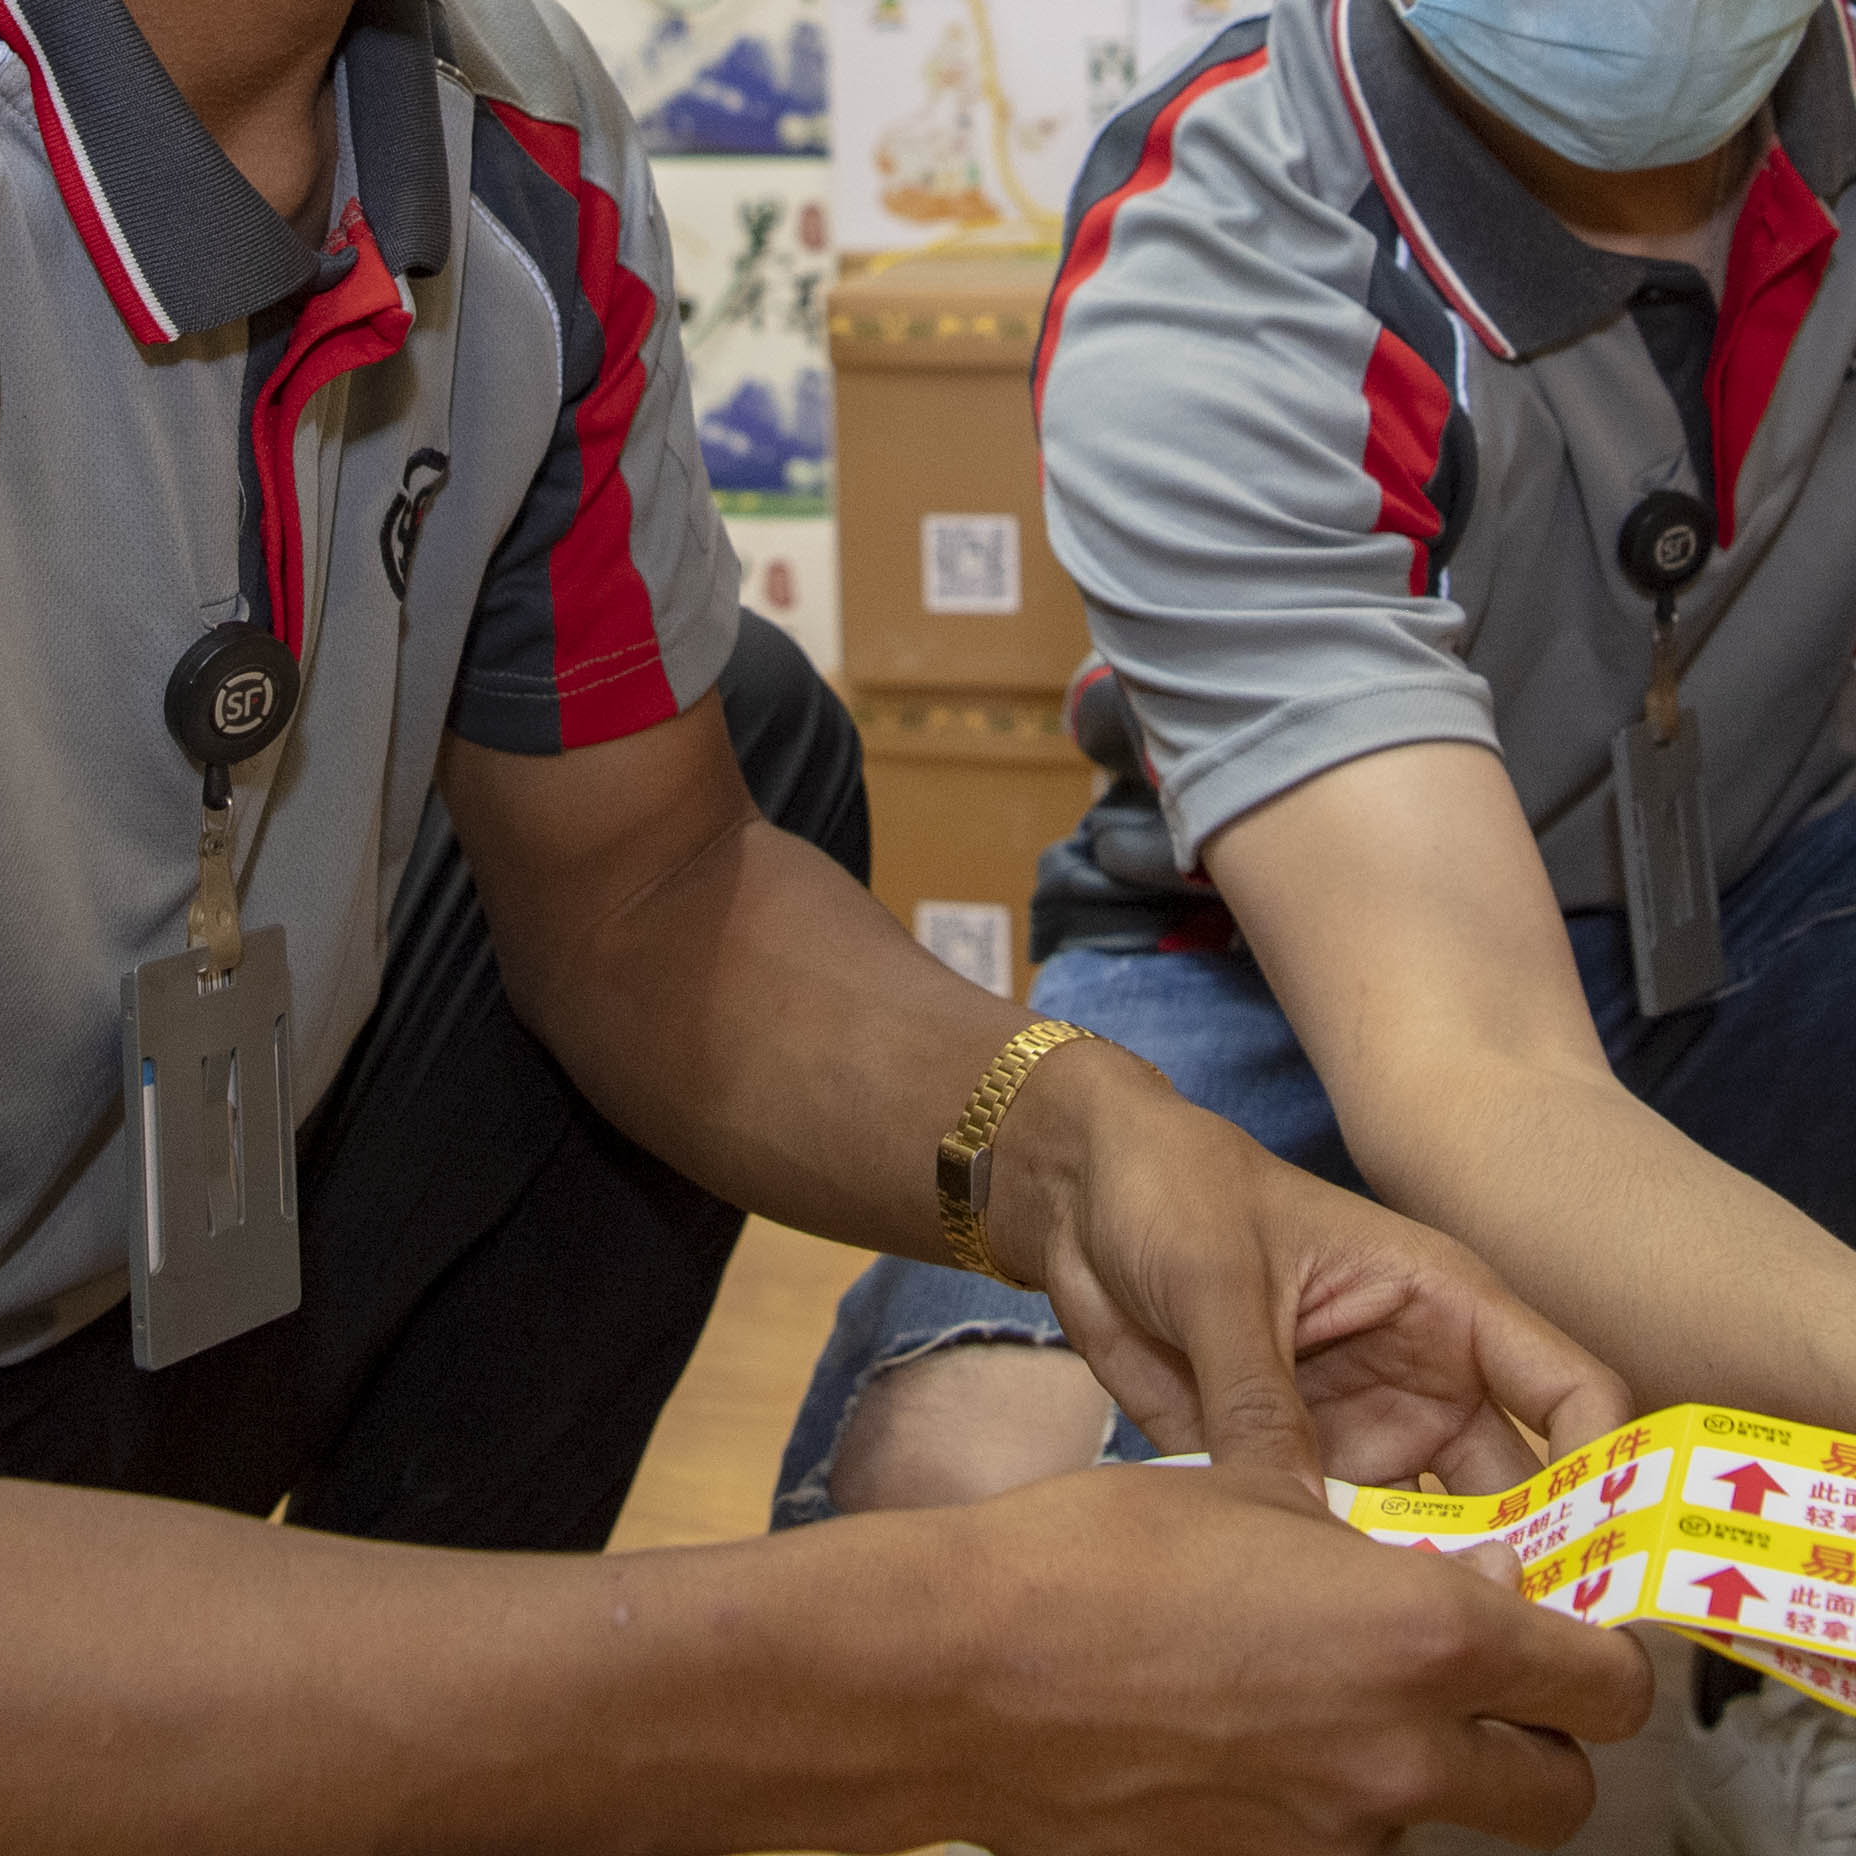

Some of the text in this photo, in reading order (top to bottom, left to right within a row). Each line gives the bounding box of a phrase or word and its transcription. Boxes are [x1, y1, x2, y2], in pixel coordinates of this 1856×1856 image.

[1488, 1427, 1652, 1530] 易碎件
[1503, 1501, 1574, 1546] 面朝上
[1521, 1529, 1626, 1602] 碎件
